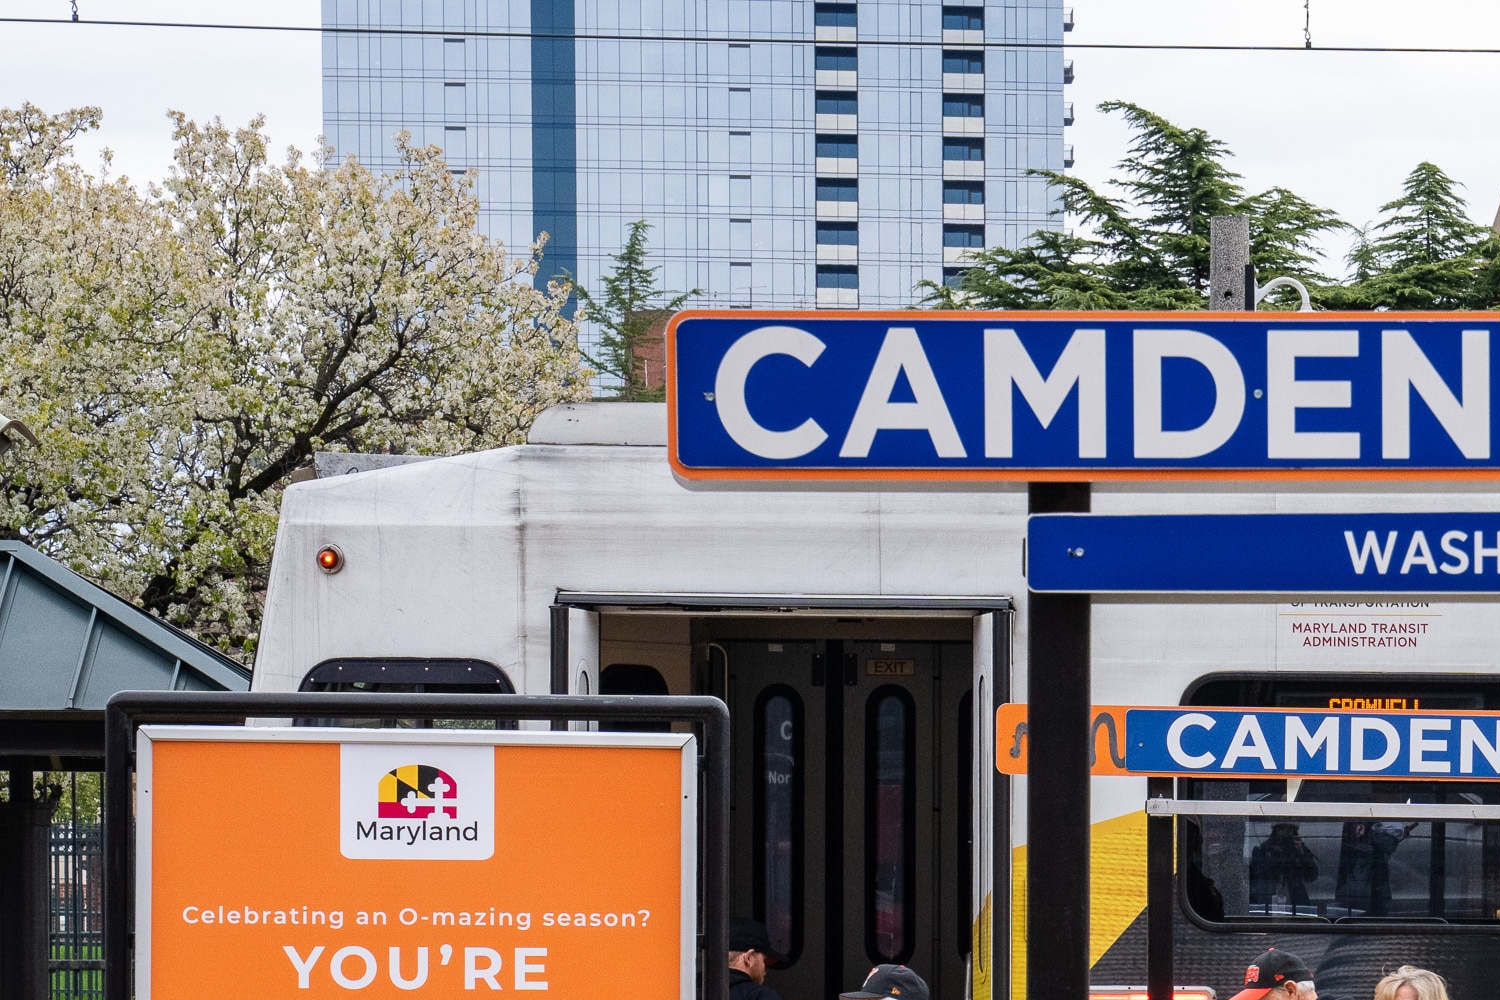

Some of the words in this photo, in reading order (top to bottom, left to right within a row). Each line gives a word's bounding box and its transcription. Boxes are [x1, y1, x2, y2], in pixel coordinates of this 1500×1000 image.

[714, 325, 1491, 461] CAMDEN
[1292, 622, 1367, 634] MARYLAND
[1371, 622, 1429, 634] TRANSIT
[1302, 636, 1417, 648] ADMINISTRATION
[873, 661, 907, 673] EXIT
[356, 820, 478, 845] Maryland
[182, 905, 344, 929] Celebrating
[355, 911, 387, 926] an
[399, 907, 531, 930] O-mazing
[543, 909, 651, 927] season?
[283, 944, 549, 991] YOU’RE
